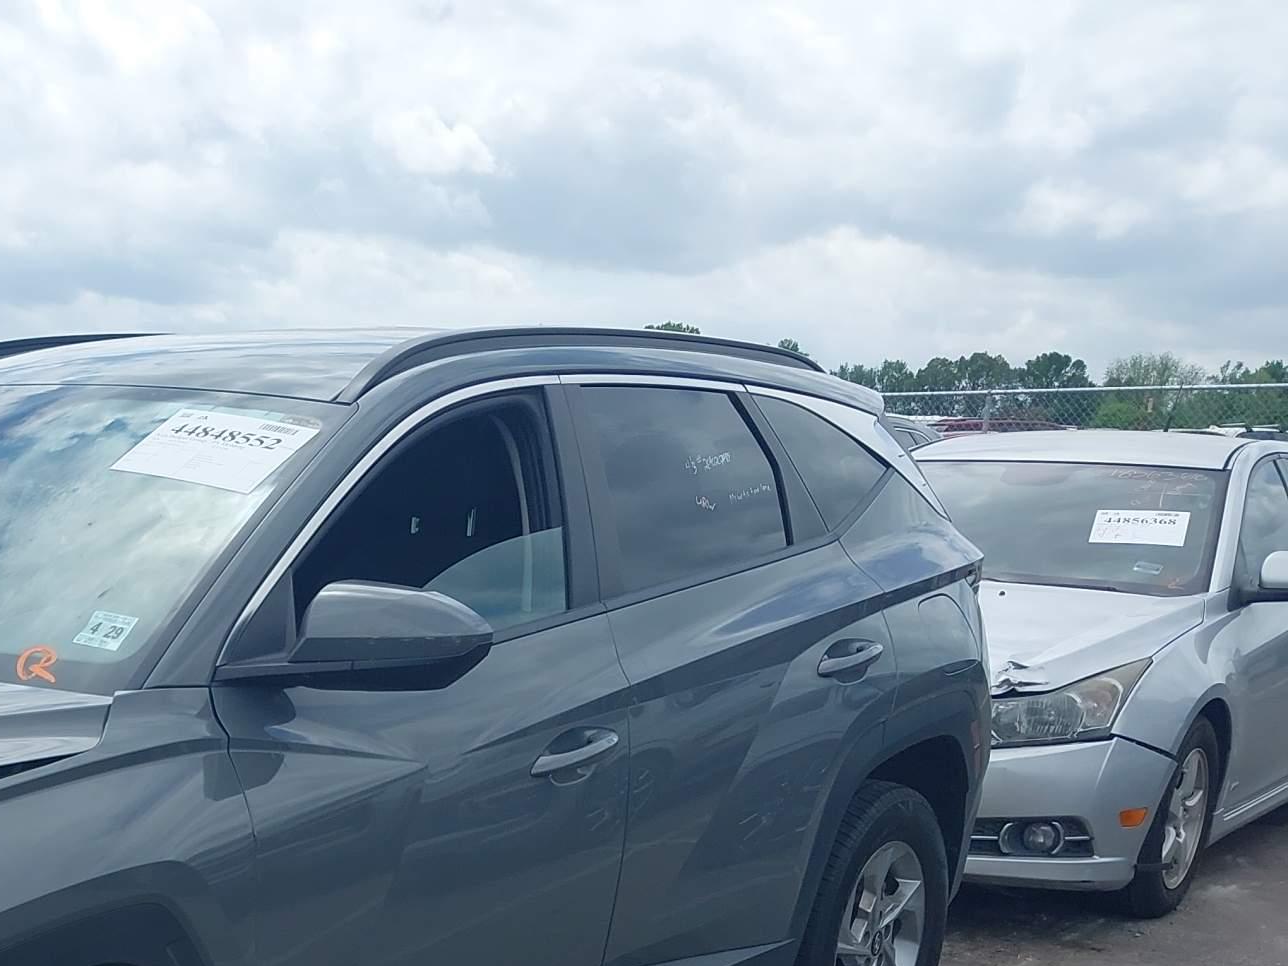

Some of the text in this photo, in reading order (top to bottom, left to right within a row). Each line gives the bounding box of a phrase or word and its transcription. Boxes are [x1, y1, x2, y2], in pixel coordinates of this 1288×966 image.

[171, 423, 283, 450] 44848552
[1104, 517, 1177, 525] 44856368
[90, 622, 124, 640] 4 29
